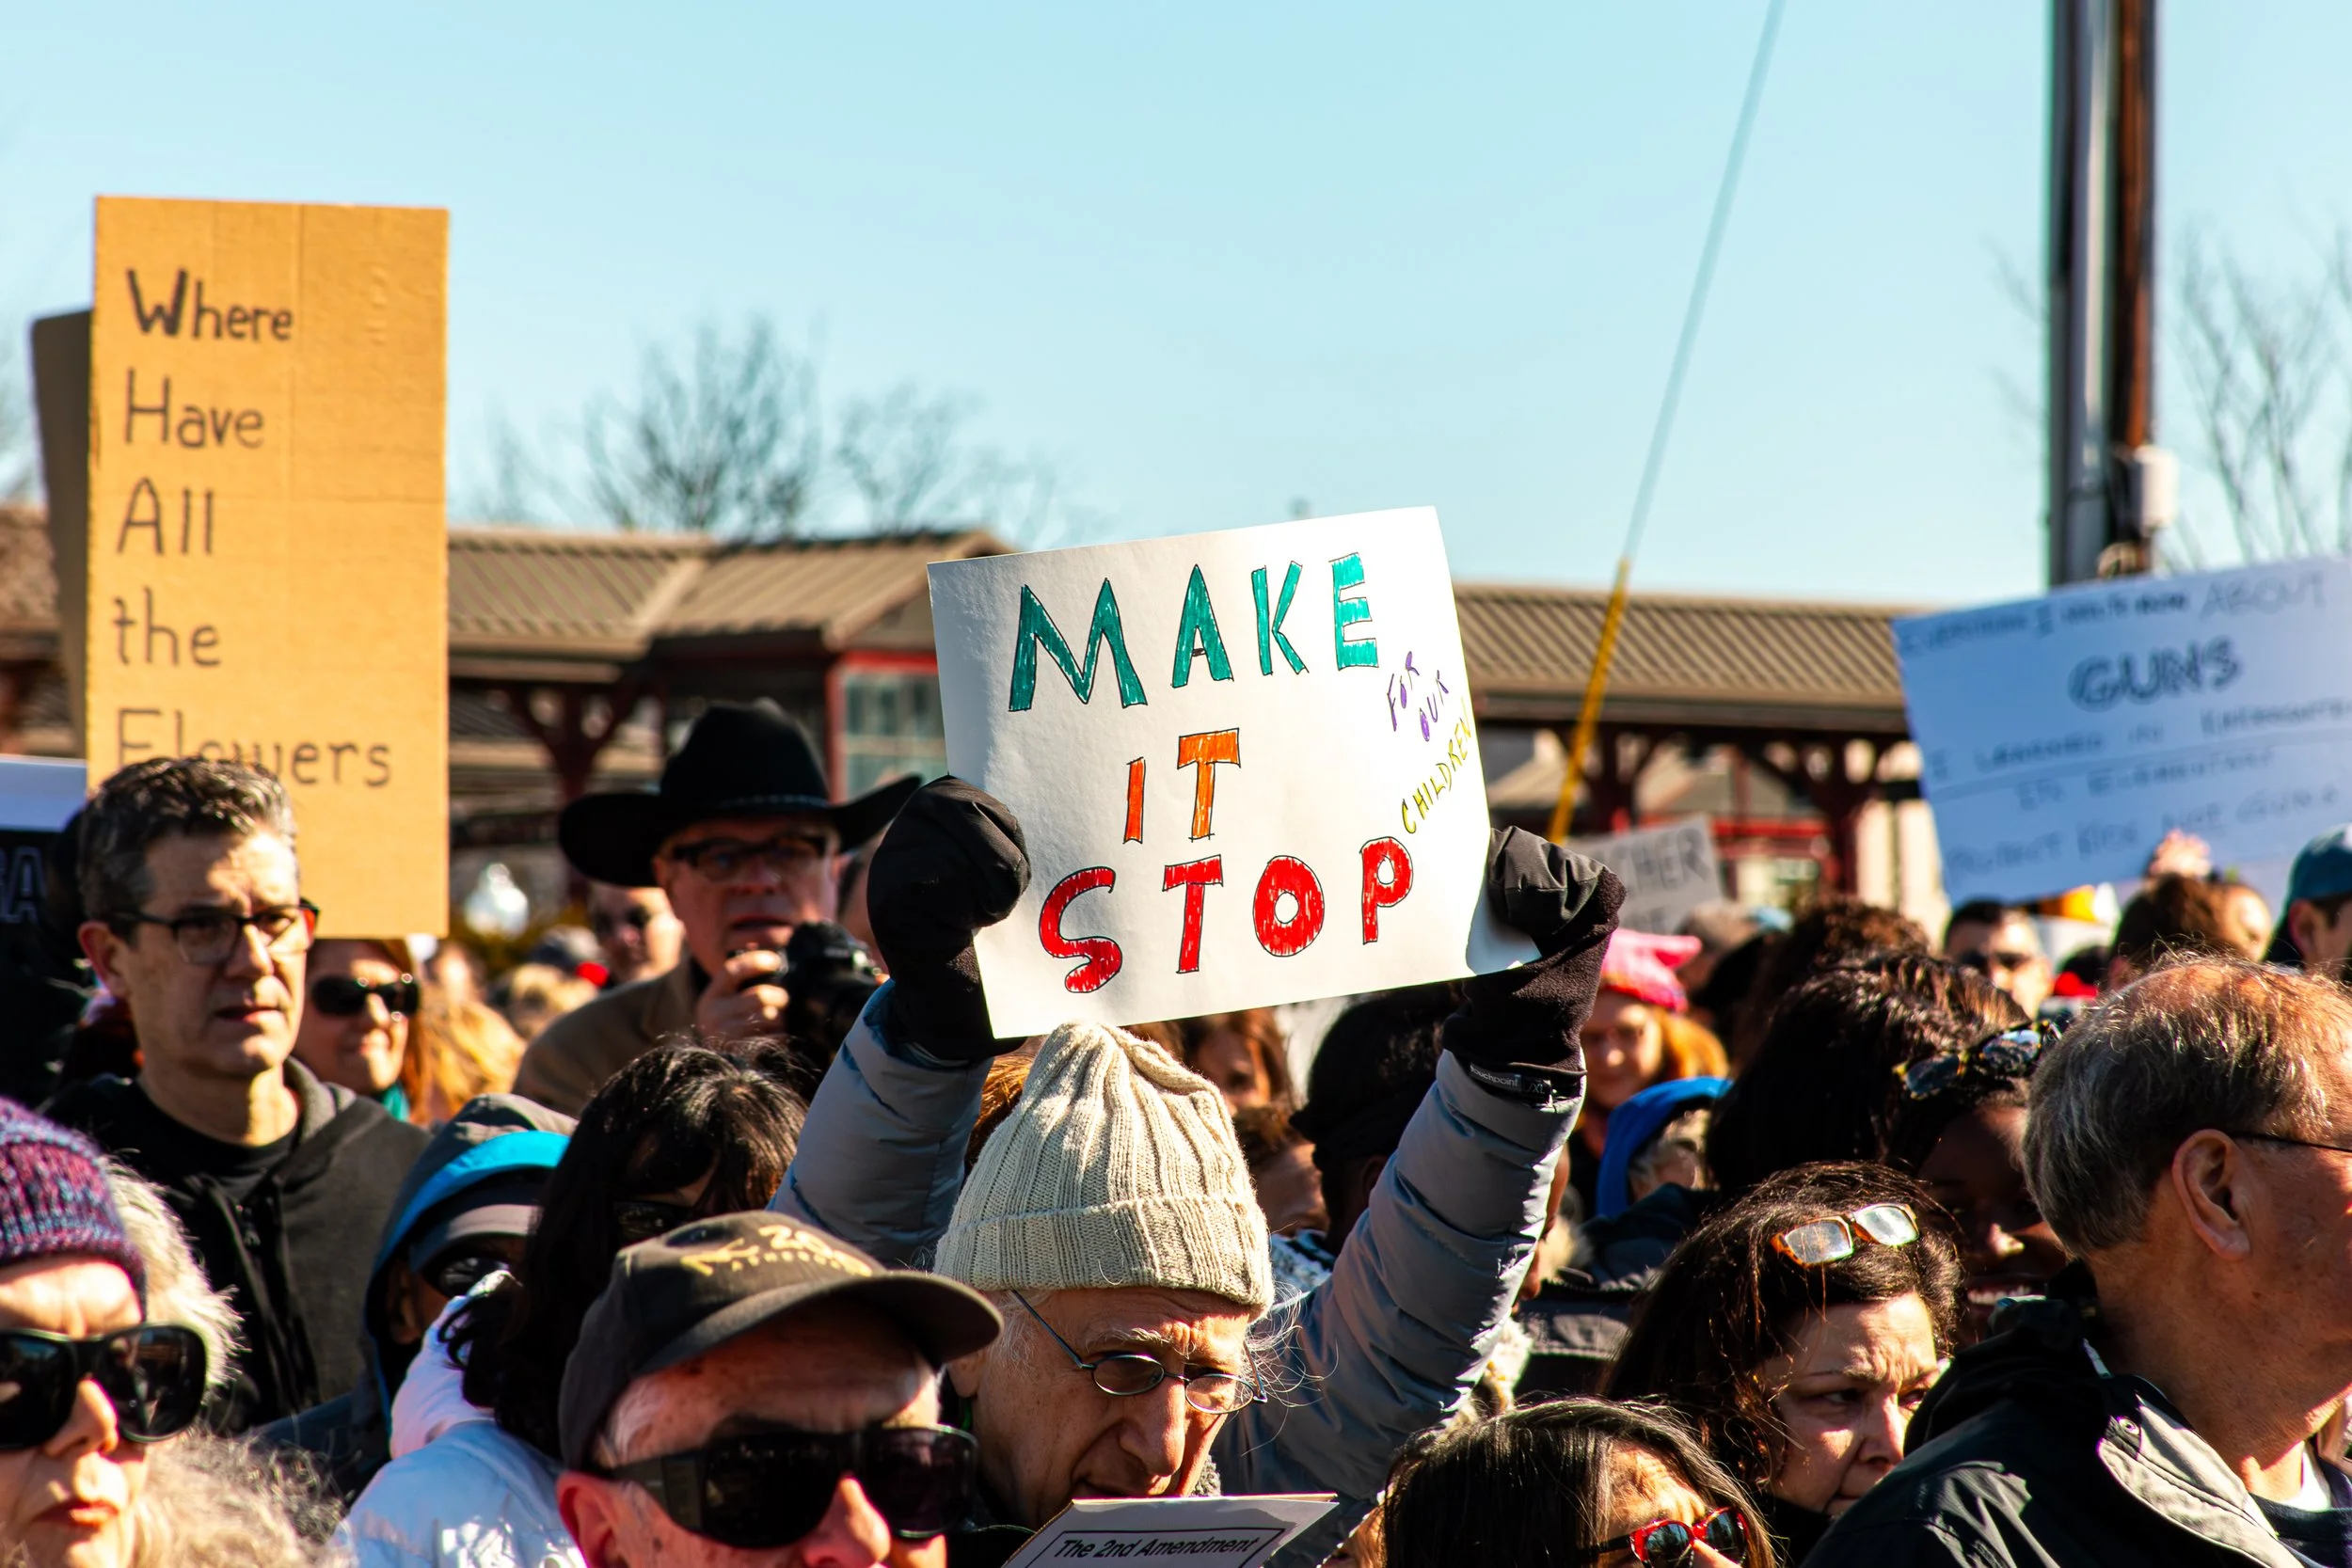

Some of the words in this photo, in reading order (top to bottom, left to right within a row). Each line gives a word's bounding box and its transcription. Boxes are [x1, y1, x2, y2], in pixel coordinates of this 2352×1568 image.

[126, 266, 294, 341] Where
[123, 365, 266, 450] Have
[116, 475, 215, 557] All
[111, 584, 223, 669] the
[1009, 551, 1380, 713] MAKE
[1387, 650, 1421, 733] FOR
[1419, 669, 1450, 742] OUR
[2068, 634, 2247, 713] GUNS
[1123, 727, 1241, 844] IT
[1401, 696, 1471, 835] CHILDREN
[1038, 836, 1414, 993] STOP
[1470, 1064, 1518, 1087] touchpoint
[1055, 1539, 1095, 1558] The
[1092, 1539, 1143, 1558] 2nd
[1135, 1536, 1261, 1557] Amendment
